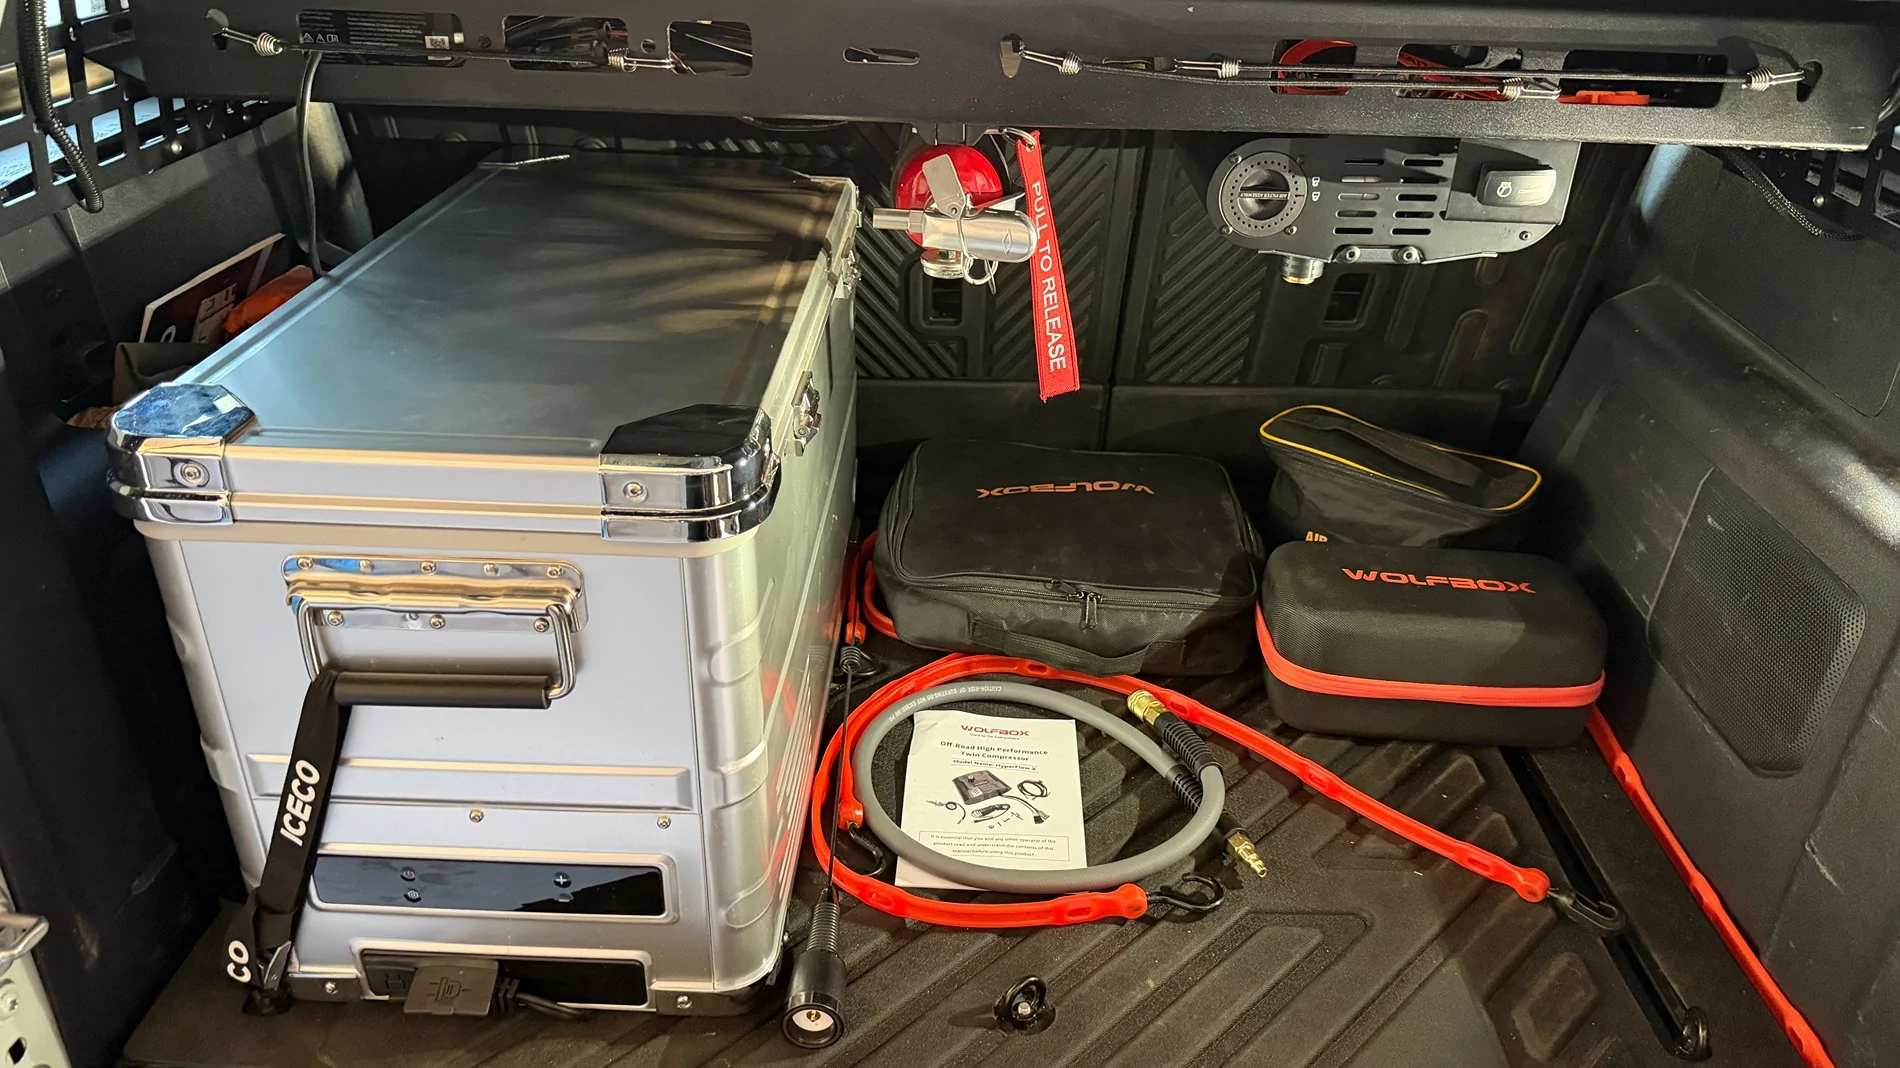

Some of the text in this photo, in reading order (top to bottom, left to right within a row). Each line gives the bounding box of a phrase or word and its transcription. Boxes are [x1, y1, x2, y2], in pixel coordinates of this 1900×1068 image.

[1031, 180, 1067, 372] PULL TO RELEASE
[976, 480, 1155, 499] WOLFBOX
[1341, 567, 1537, 594] WOLFBOX
[960, 724, 1030, 736] WOLFBOX
[940, 740, 975, 750] Off-Road
[996, 746, 1048, 755] Performance
[981, 753, 1029, 761] Compressor
[280, 759, 321, 847] ICECO
[227, 939, 252, 983] CO
